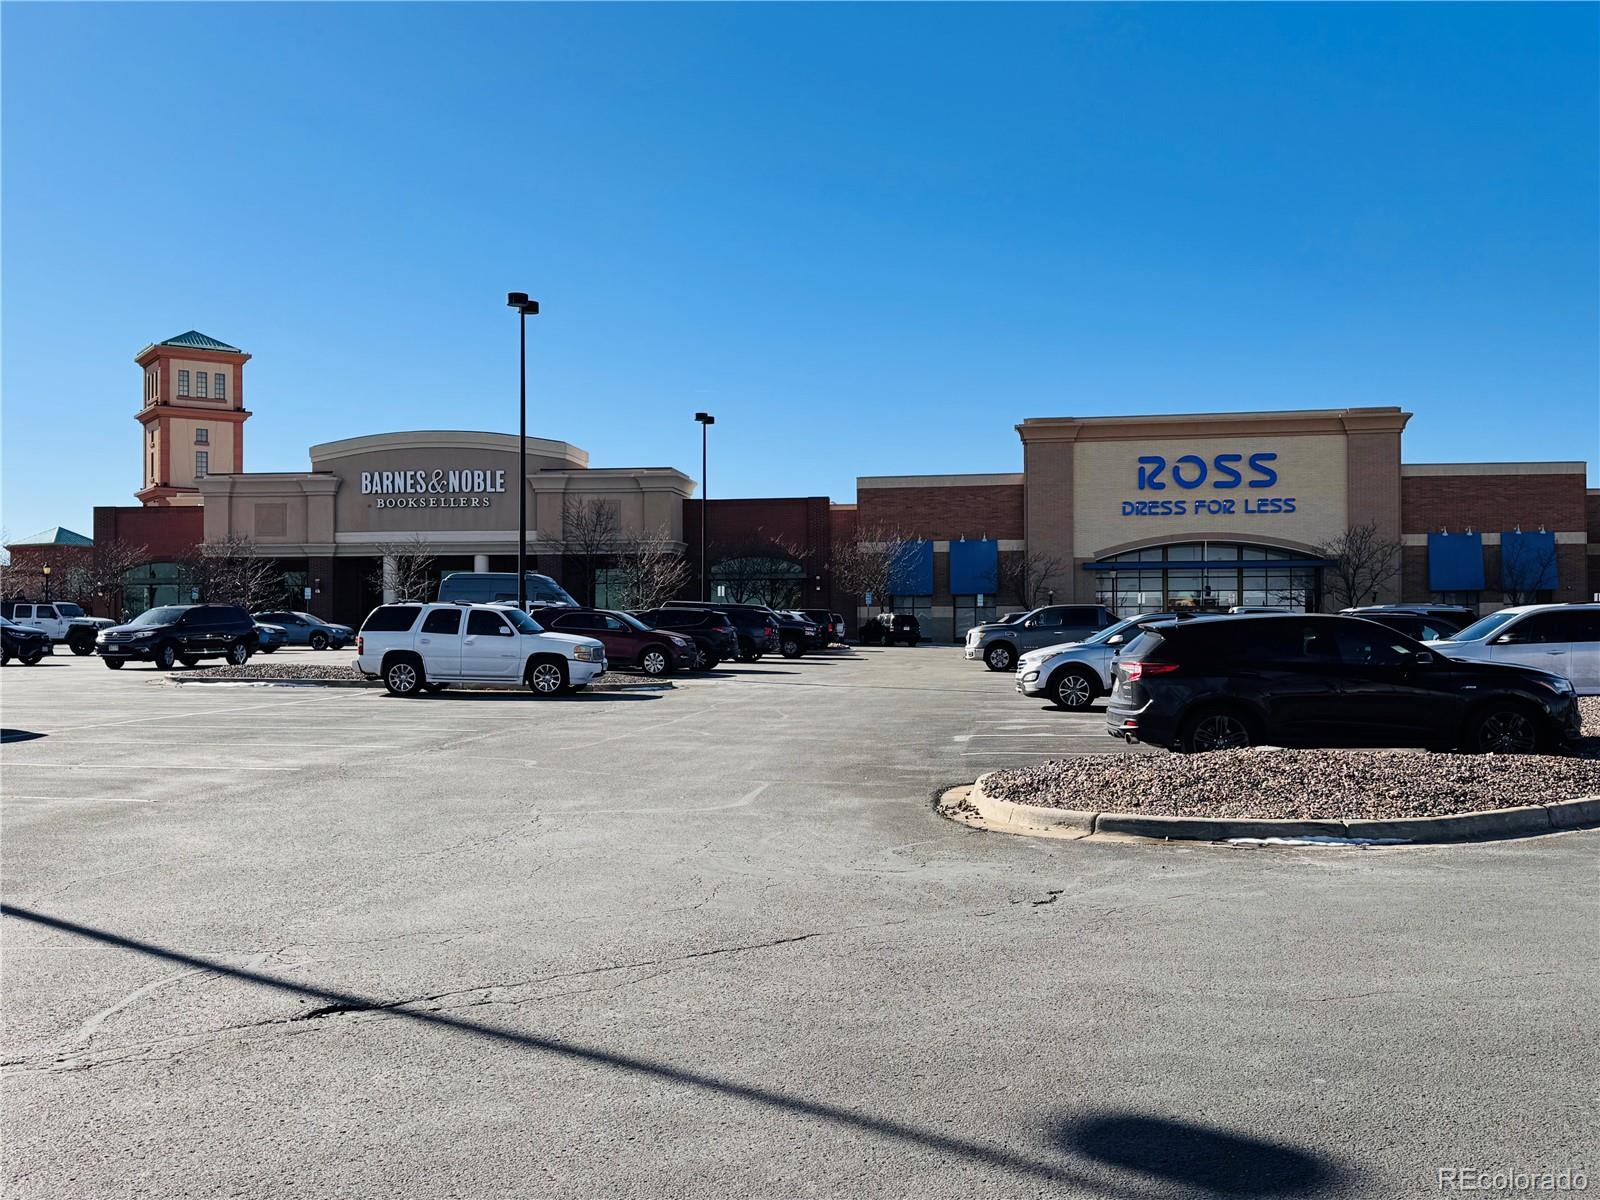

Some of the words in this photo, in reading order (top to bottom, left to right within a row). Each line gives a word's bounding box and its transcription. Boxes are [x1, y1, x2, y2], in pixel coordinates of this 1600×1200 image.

[1138, 453, 1277, 490] ROSS
[376, 497, 490, 508] BOOKSELLERS
[1122, 500, 1186, 516] DRESS
[1195, 499, 1235, 515] FOR
[1244, 498, 1296, 514] LESS
